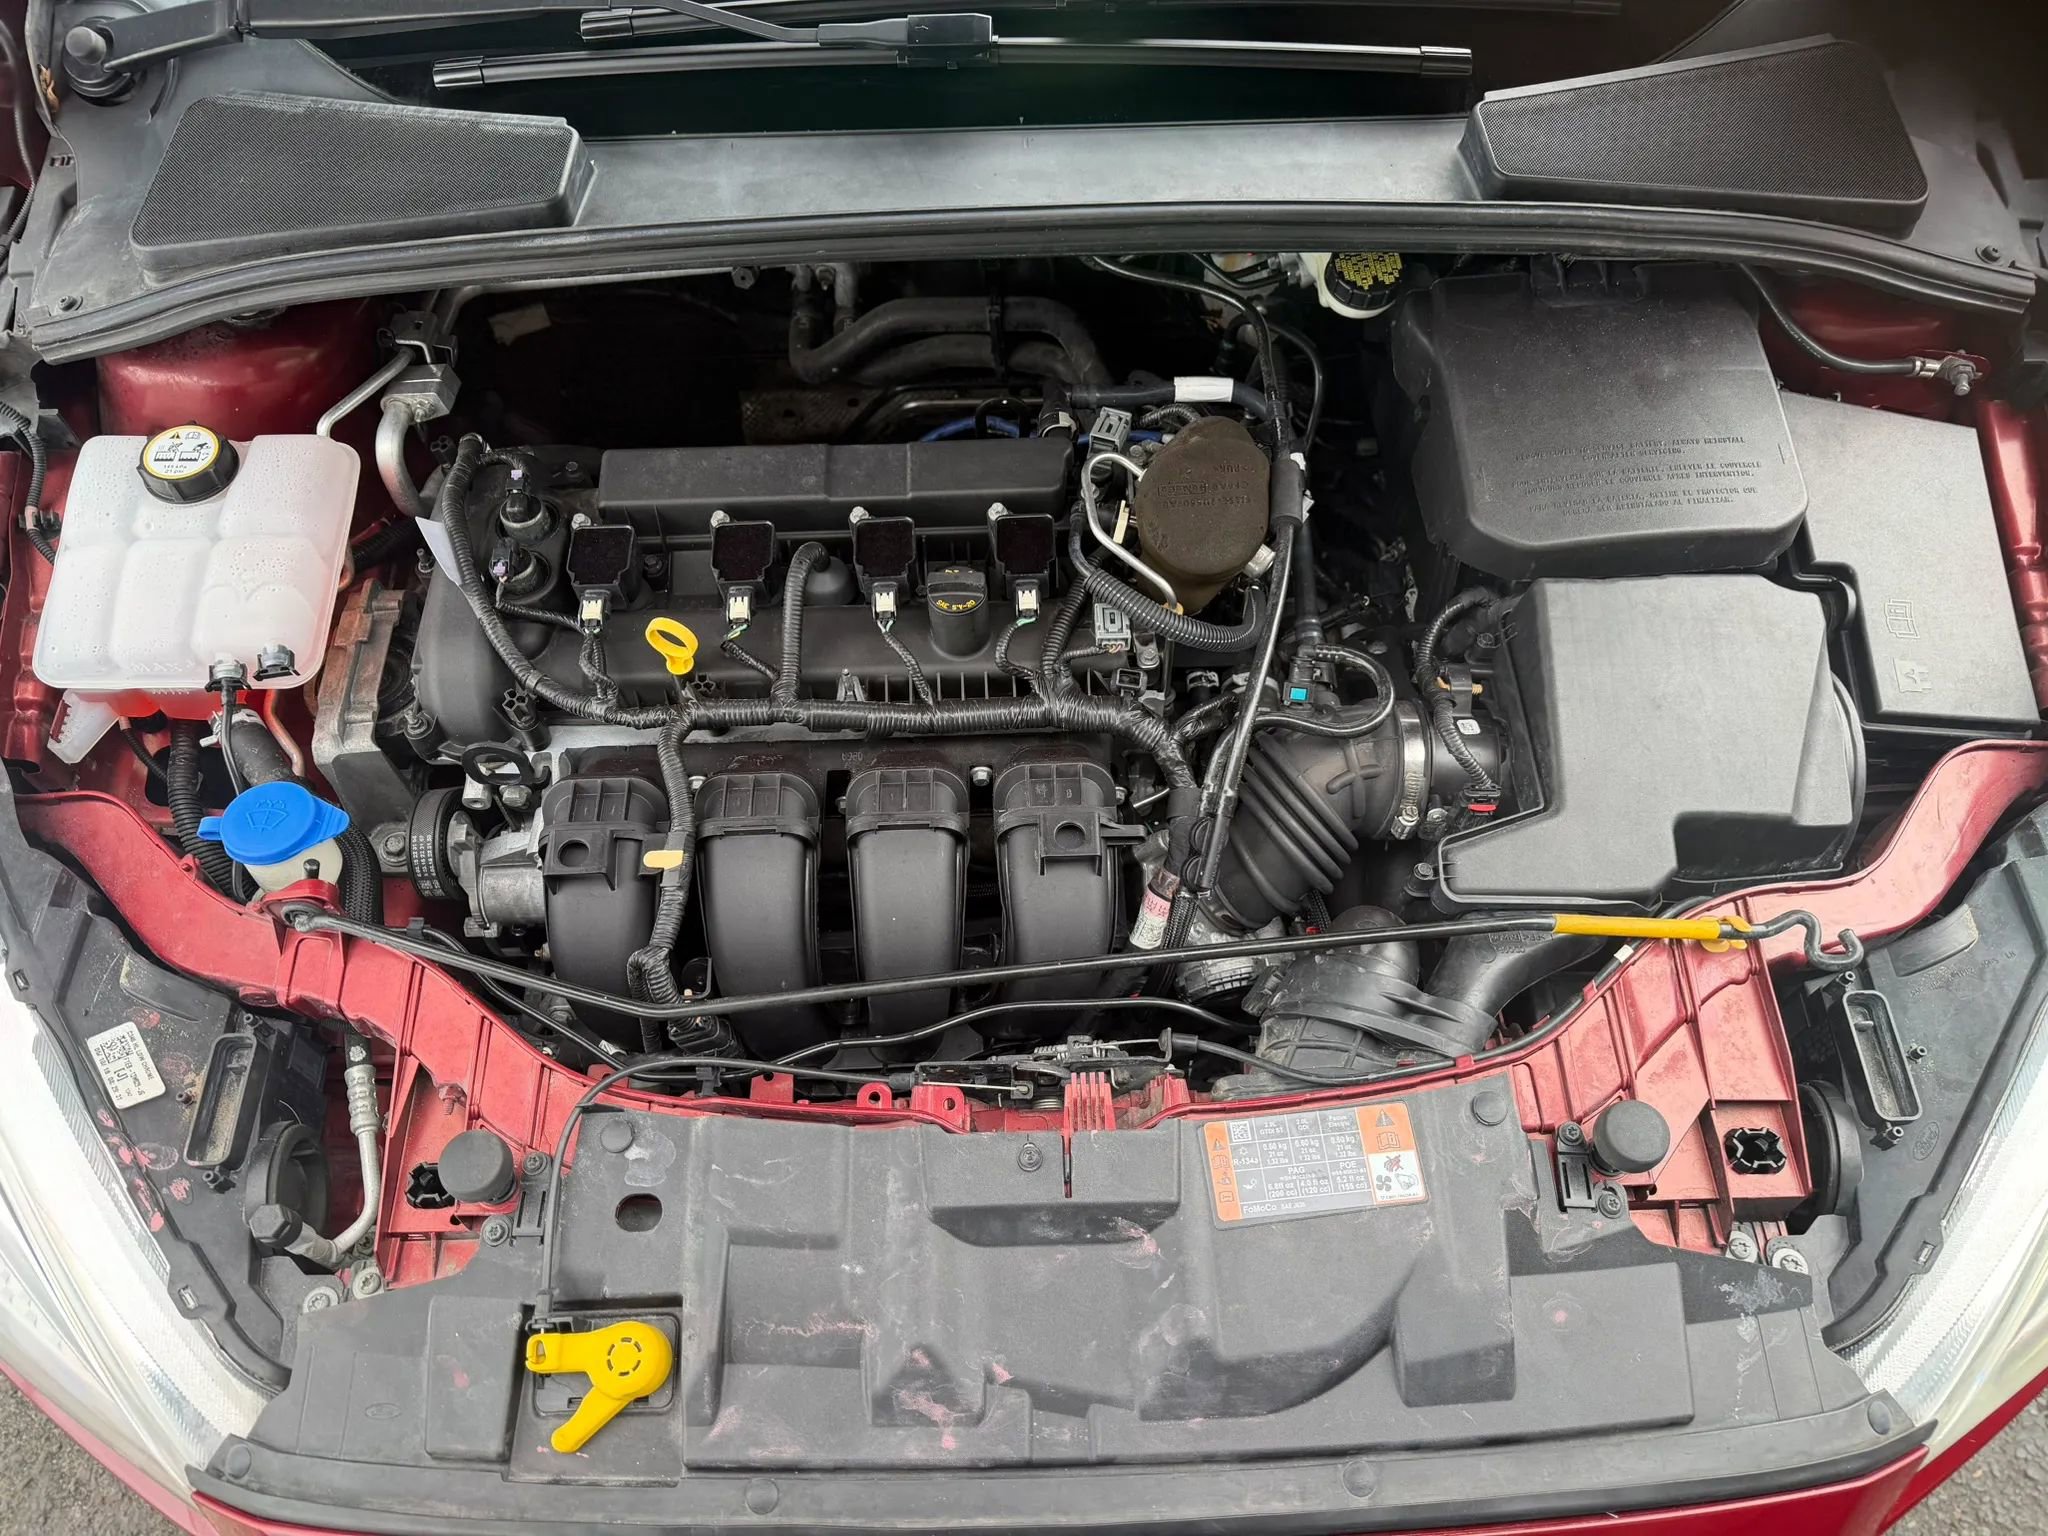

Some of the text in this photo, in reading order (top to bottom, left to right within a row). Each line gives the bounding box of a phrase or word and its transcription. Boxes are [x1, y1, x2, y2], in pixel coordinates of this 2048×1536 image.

[936, 600, 950, 609] SAE
[1278, 1142, 1288, 1151] kg
[1311, 1138, 1320, 1148] kg
[1339, 1161, 1357, 1169] POE
[1288, 1166, 1305, 1174] PAG
[1243, 1203, 1277, 1214] FoMoCo
